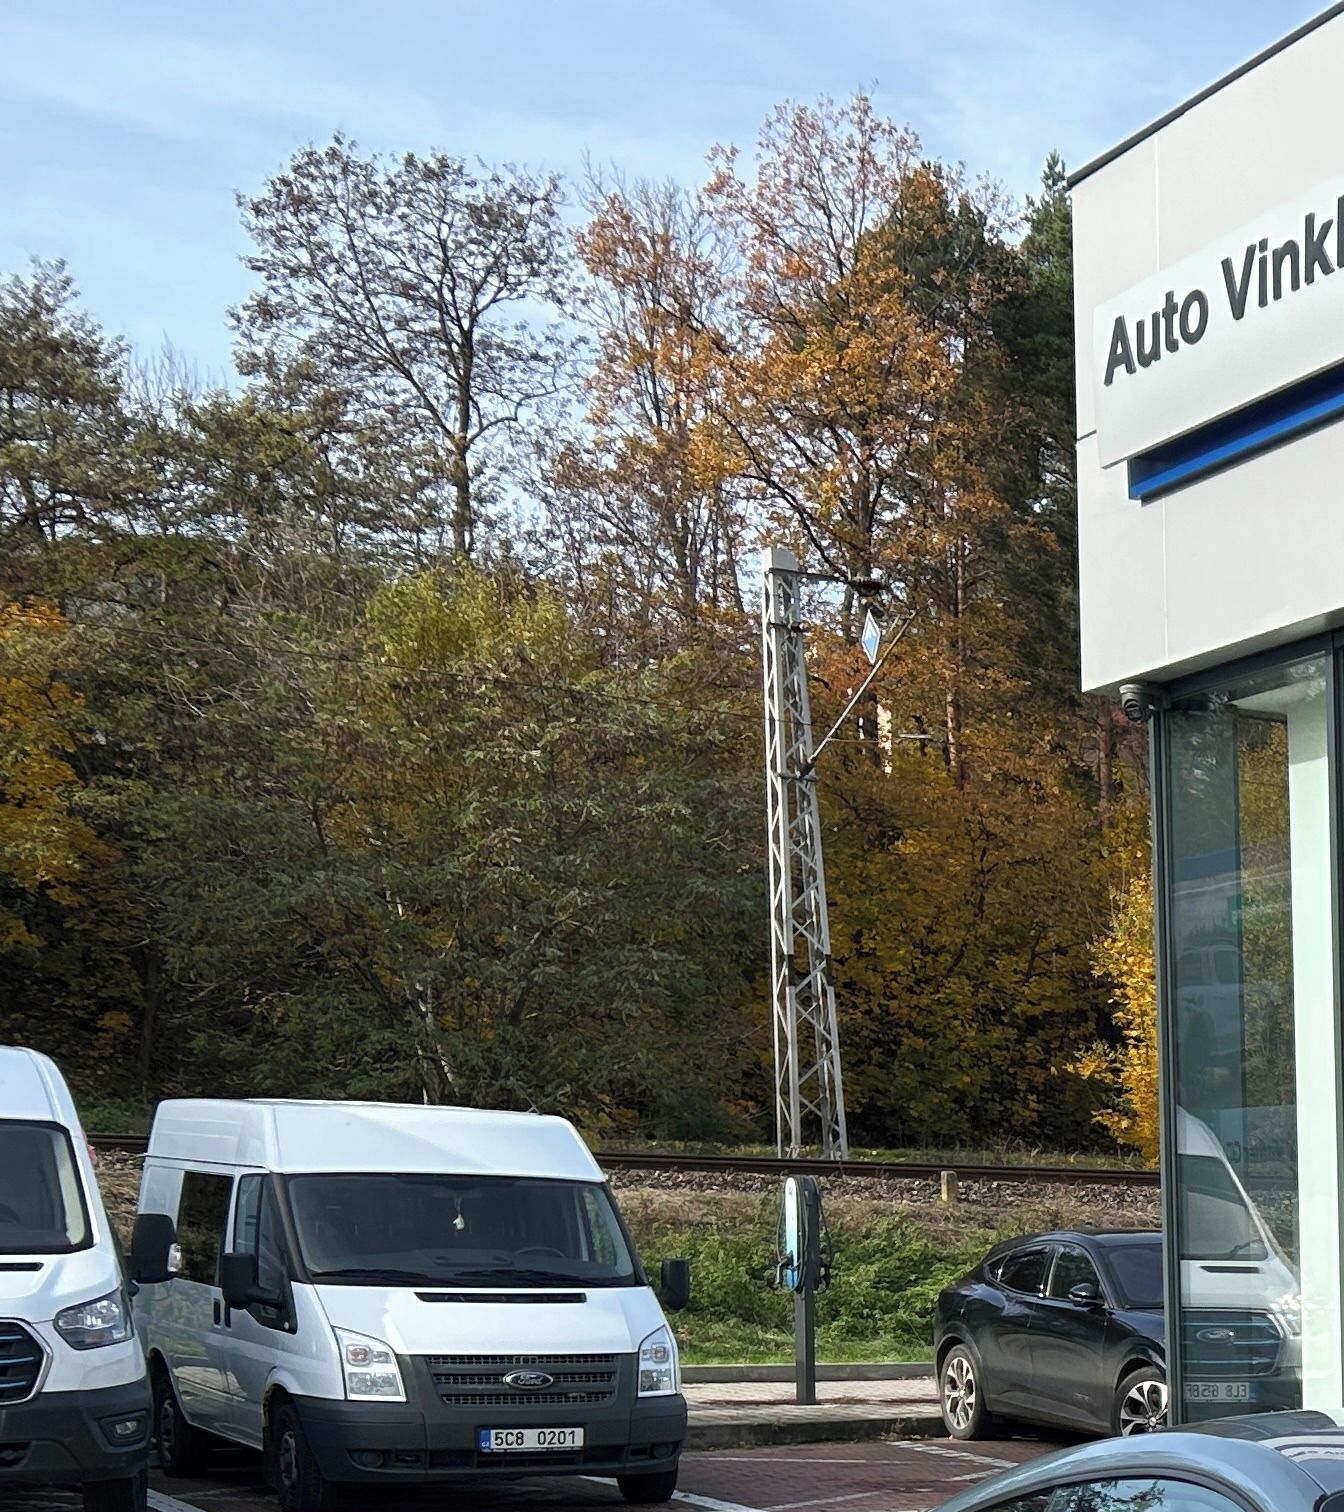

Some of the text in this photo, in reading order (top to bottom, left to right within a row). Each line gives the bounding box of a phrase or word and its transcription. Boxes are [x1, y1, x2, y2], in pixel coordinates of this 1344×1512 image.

[1104, 289, 1209, 387] Auto
[494, 1430, 576, 1447] 5C8 0201
